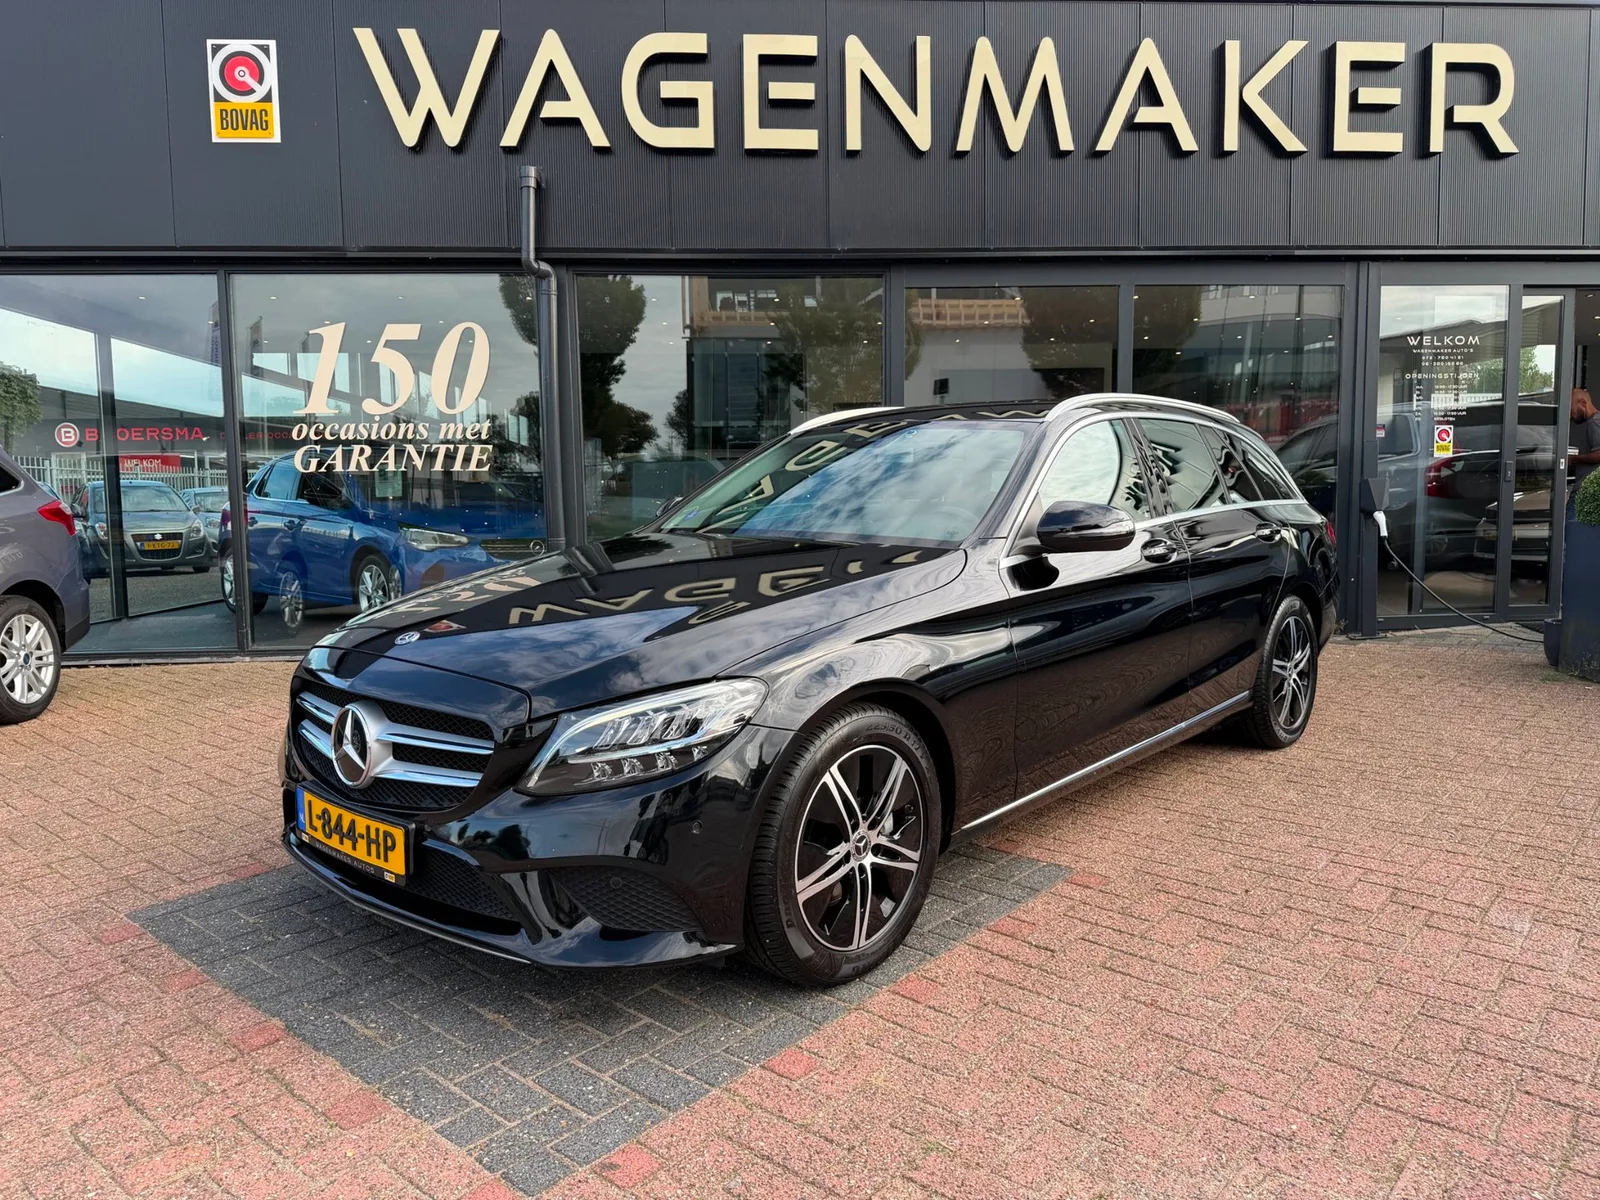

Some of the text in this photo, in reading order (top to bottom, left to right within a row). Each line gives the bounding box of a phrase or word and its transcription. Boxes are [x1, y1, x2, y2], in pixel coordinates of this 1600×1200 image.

[353, 28, 1519, 154] WAGENMAKER
[220, 108, 269, 131] BOVAG
[1407, 335, 1480, 346] WELKOM
[293, 321, 490, 415] 150
[1405, 372, 1479, 380] OPENINGSTIJDEN
[85, 427, 204, 441] BOERSMA
[291, 415, 491, 441] occasions met
[293, 443, 493, 473] GARANTIE
[308, 799, 397, 863] L-844-HP
